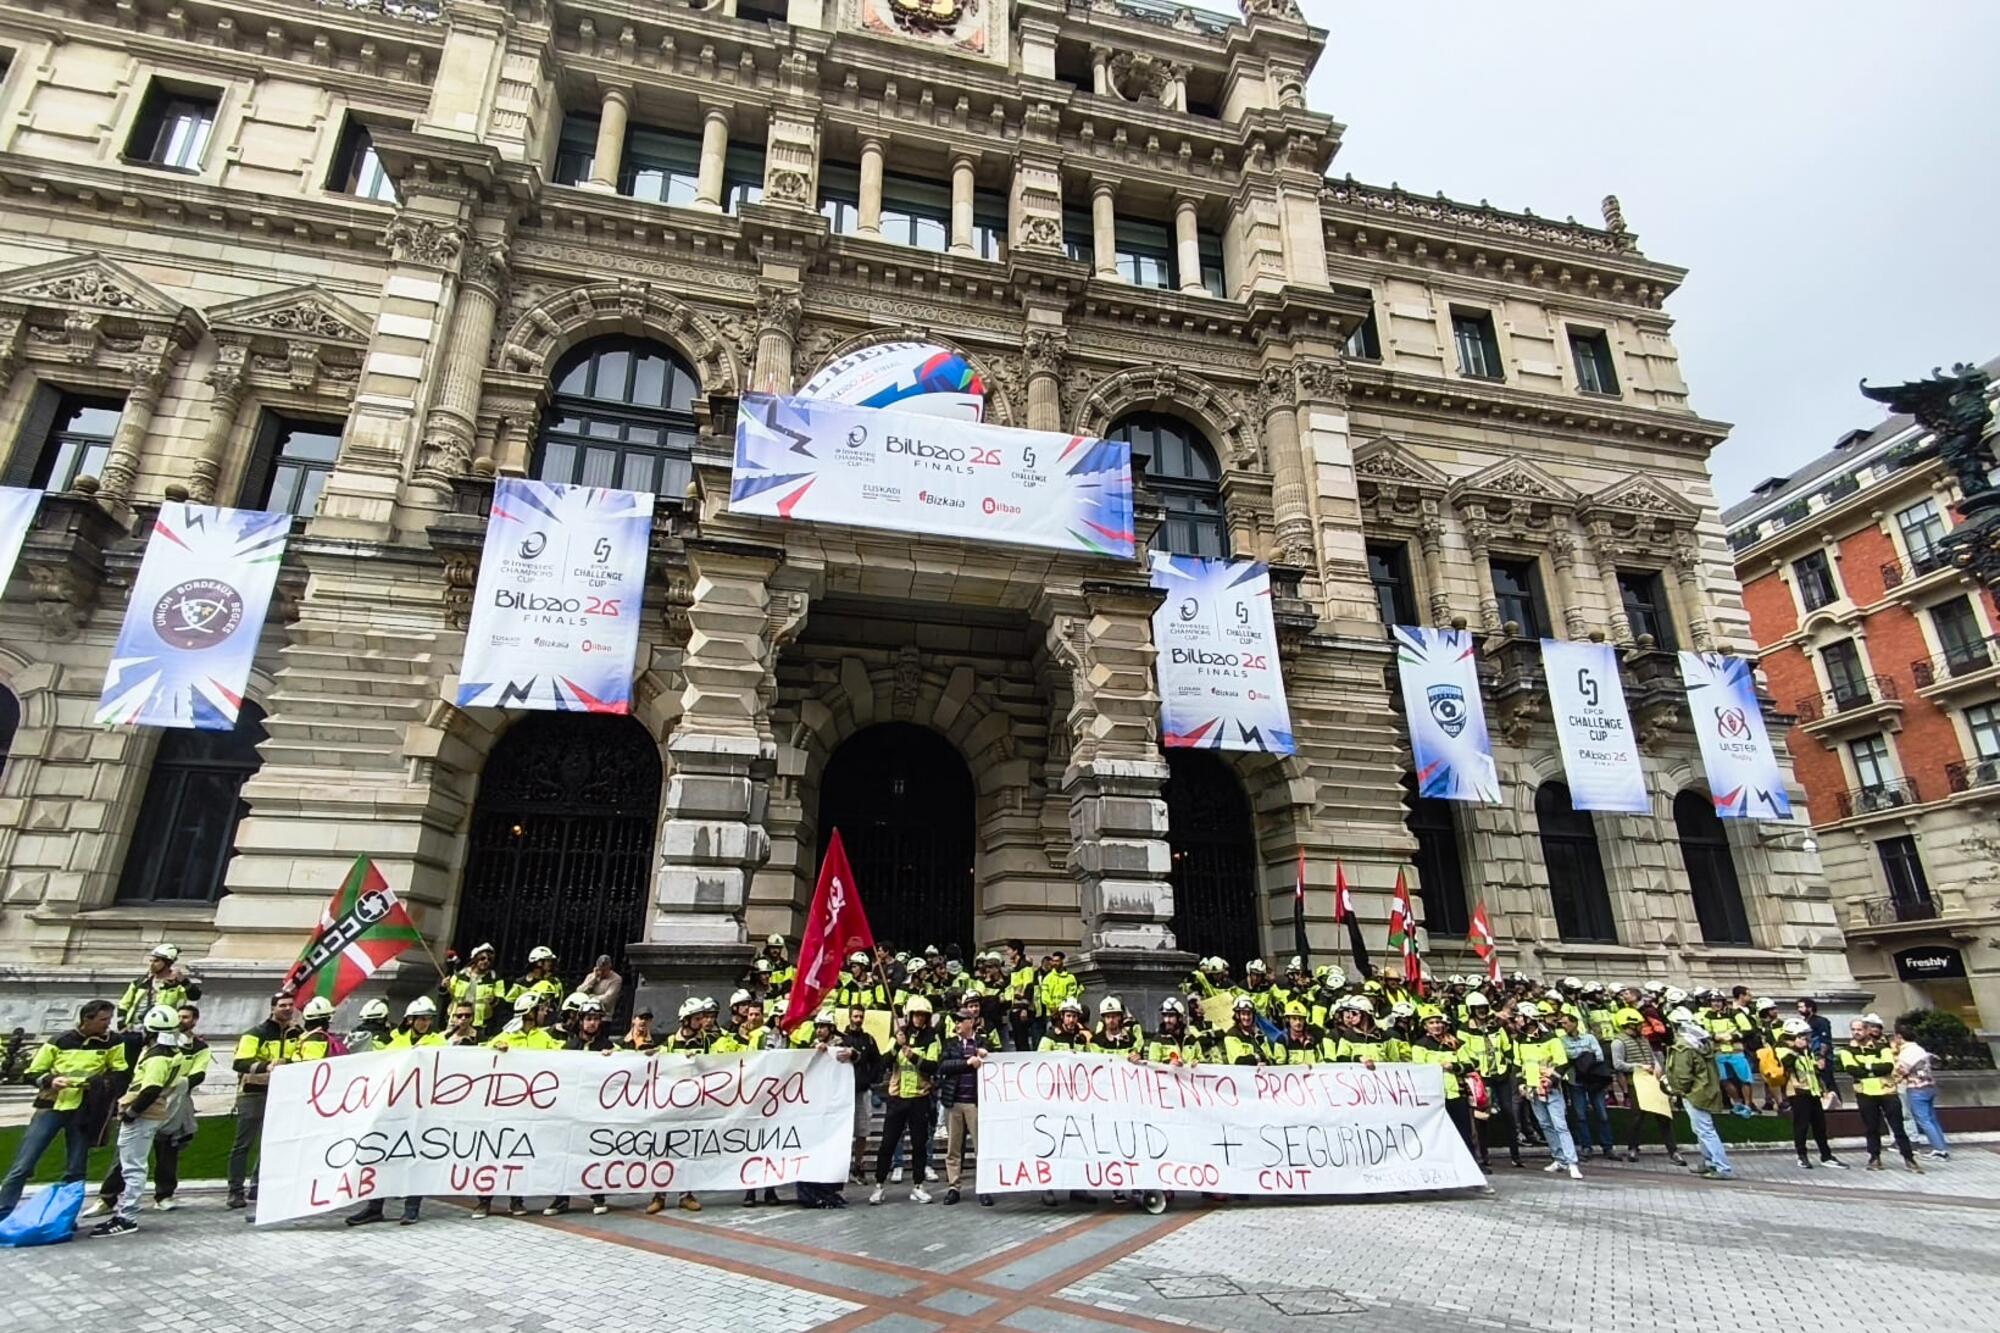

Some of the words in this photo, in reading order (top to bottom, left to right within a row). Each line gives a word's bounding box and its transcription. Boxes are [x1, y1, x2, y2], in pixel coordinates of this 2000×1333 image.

[886, 435, 965, 462] Bilbao
[970, 446, 1002, 465] 26
[914, 459, 975, 475] FINALS
[926, 494, 966, 508] Bizkaia
[574, 568, 623, 581] CHALLENGE
[177, 581, 234, 597] BORDEAUX
[588, 579, 607, 587] CUP
[495, 589, 581, 612] Bilbao
[584, 596, 621, 616] 26
[156, 596, 173, 626] UNION
[524, 614, 588, 626] FINALS
[1172, 648, 1238, 666] Bilbao
[1241, 653, 1266, 670] 26
[1198, 668, 1248, 678] FINALS
[1569, 716, 1623, 729] CHALLENGE
[1590, 730, 1607, 741] CUP
[1906, 957, 1948, 968] Freshly
[1255, 1069, 1430, 1108] PROFESIONAL
[325, 1127, 535, 1168] OSASUNA
[1032, 1113, 1169, 1160] SALUD
[1211, 1124, 1243, 1166] +
[310, 1166, 377, 1206] LAB
[450, 1163, 523, 1192] UGT
[581, 1160, 675, 1189] CCOO
[740, 1155, 810, 1185] CNT
[999, 1160, 1052, 1186] LAB
[1085, 1161, 1139, 1187] UGT
[1158, 1163, 1220, 1187] CCOO
[1259, 1170, 1311, 1191] CNT
